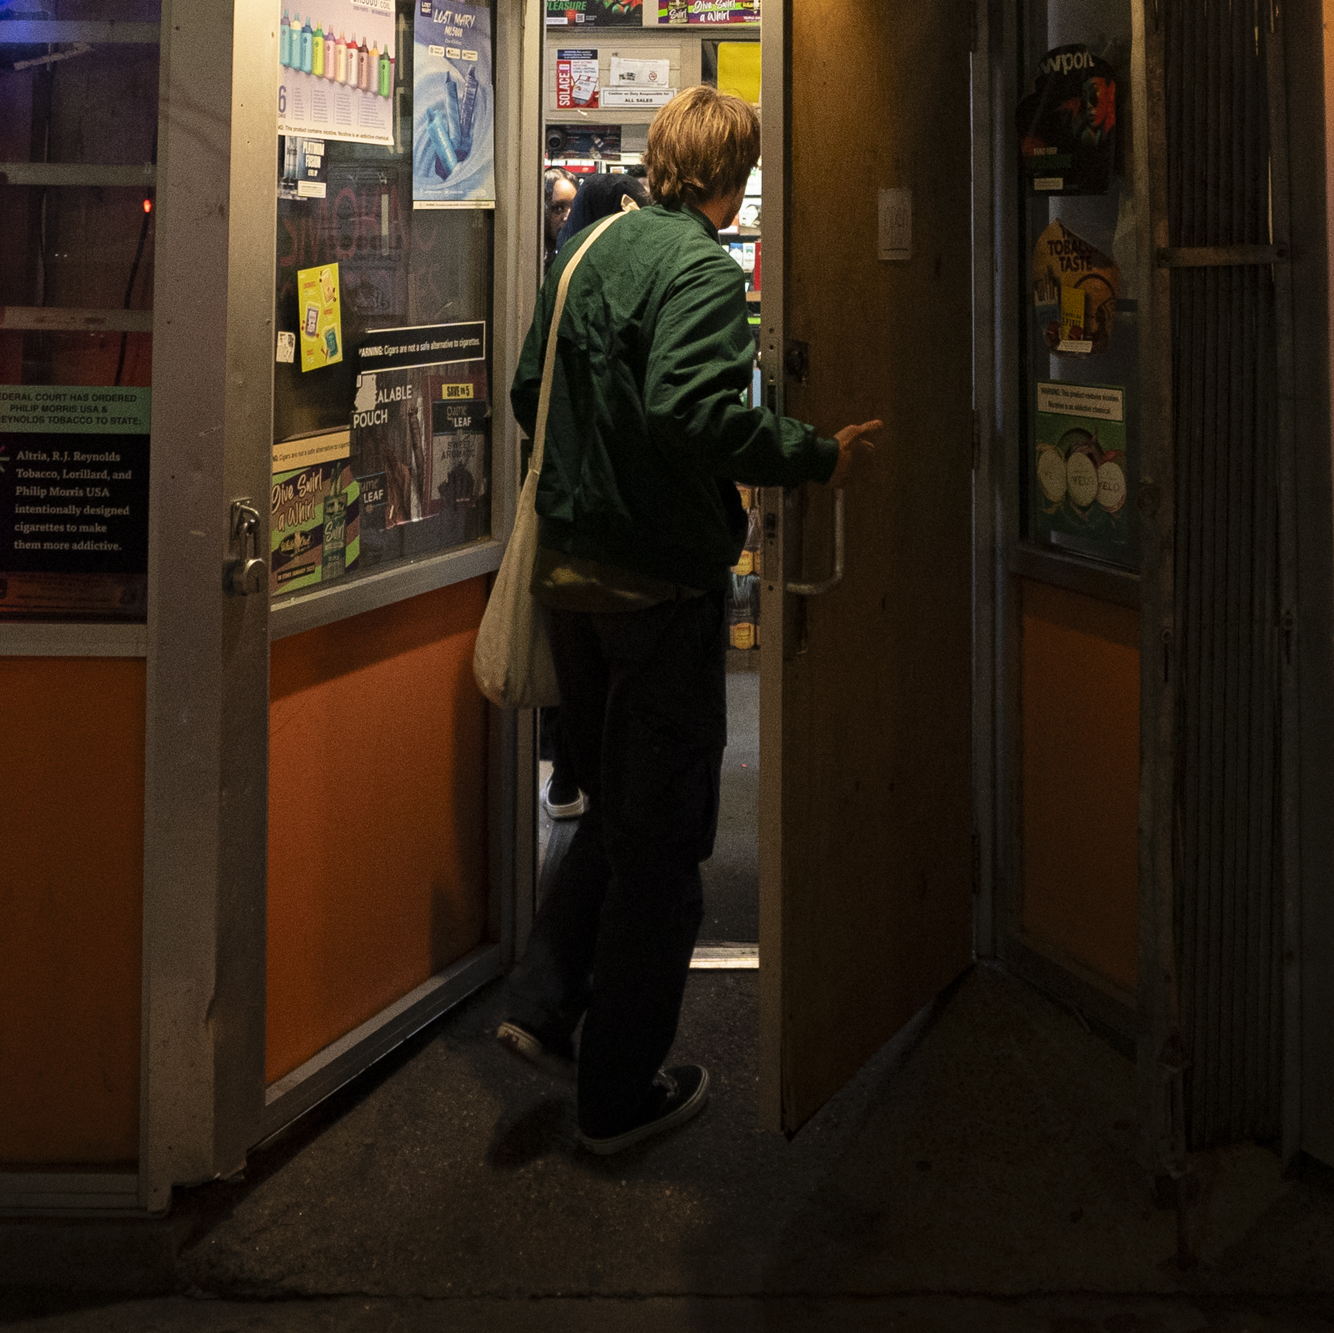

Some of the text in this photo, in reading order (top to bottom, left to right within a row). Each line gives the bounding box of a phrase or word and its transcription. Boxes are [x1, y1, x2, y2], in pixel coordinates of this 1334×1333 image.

[559, 72, 571, 106] SOLACE
[1059, 255, 1093, 272] TASTE
[384, 345, 399, 357] Cigars
[446, 385, 460, 397] SAVE
[35, 393, 67, 402] COURT
[69, 394, 88, 402] HAS
[91, 394, 137, 403] ORDERED
[9, 404, 108, 414] PHILIP MORRIS USA &
[47, 416, 93, 425] TOBACCO
[96, 417, 108, 425] TO
[353, 409, 388, 429] POUCH
[454, 416, 472, 428] LEAF
[16, 450, 121, 465] Altria, R.J. Reynolds
[16, 468, 133, 481] Tobacco, Lorillard, and
[15, 486, 110, 499] Philip Morris USA
[272, 467, 323, 515] Give Swirl
[362, 489, 384, 504] LEAF
[15, 504, 130, 518] intentionally designed
[287, 495, 316, 527] Whirl
[14, 521, 108, 535] cigarettes to make
[14, 539, 122, 552] them more addictive.
